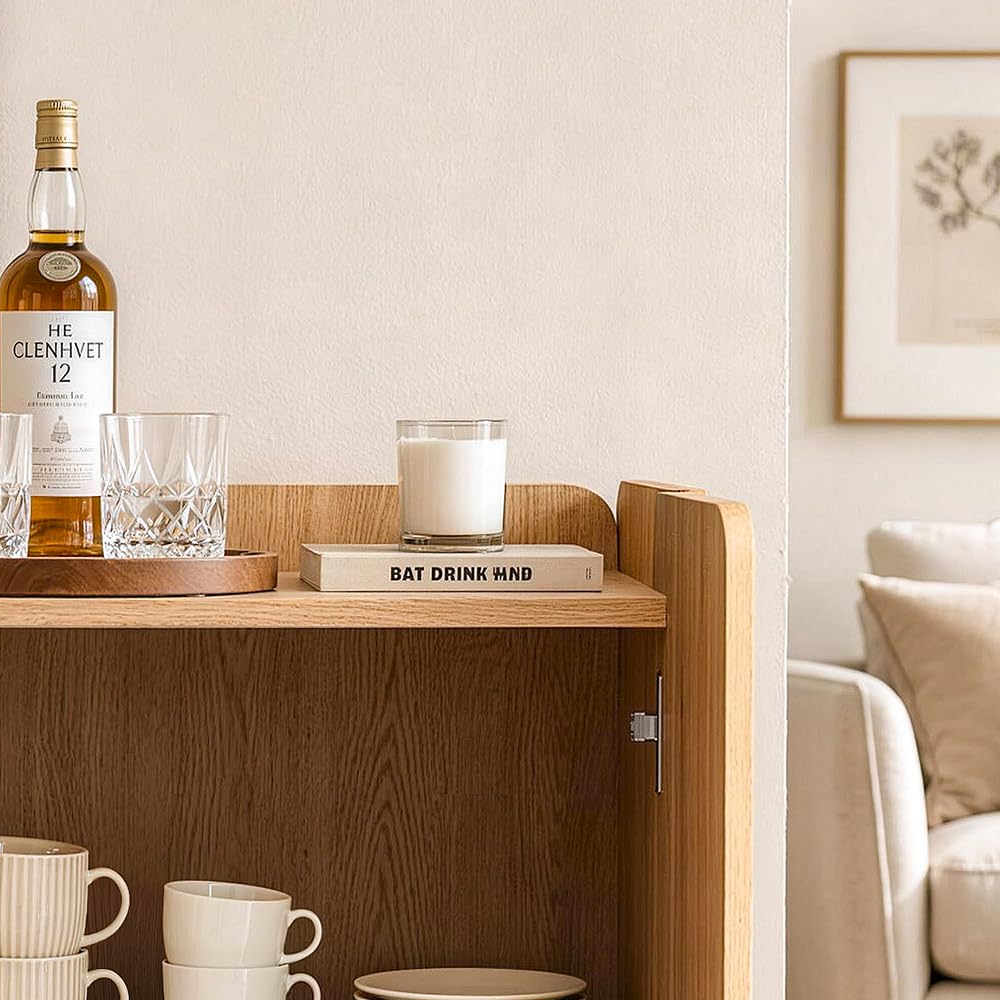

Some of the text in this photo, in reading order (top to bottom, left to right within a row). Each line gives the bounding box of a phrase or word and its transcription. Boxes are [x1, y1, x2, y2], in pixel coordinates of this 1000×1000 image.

[48, 324, 73, 338] HE
[50, 362, 72, 383] 12
[389, 566, 425, 582] BAT
[430, 566, 489, 582] DRINK
